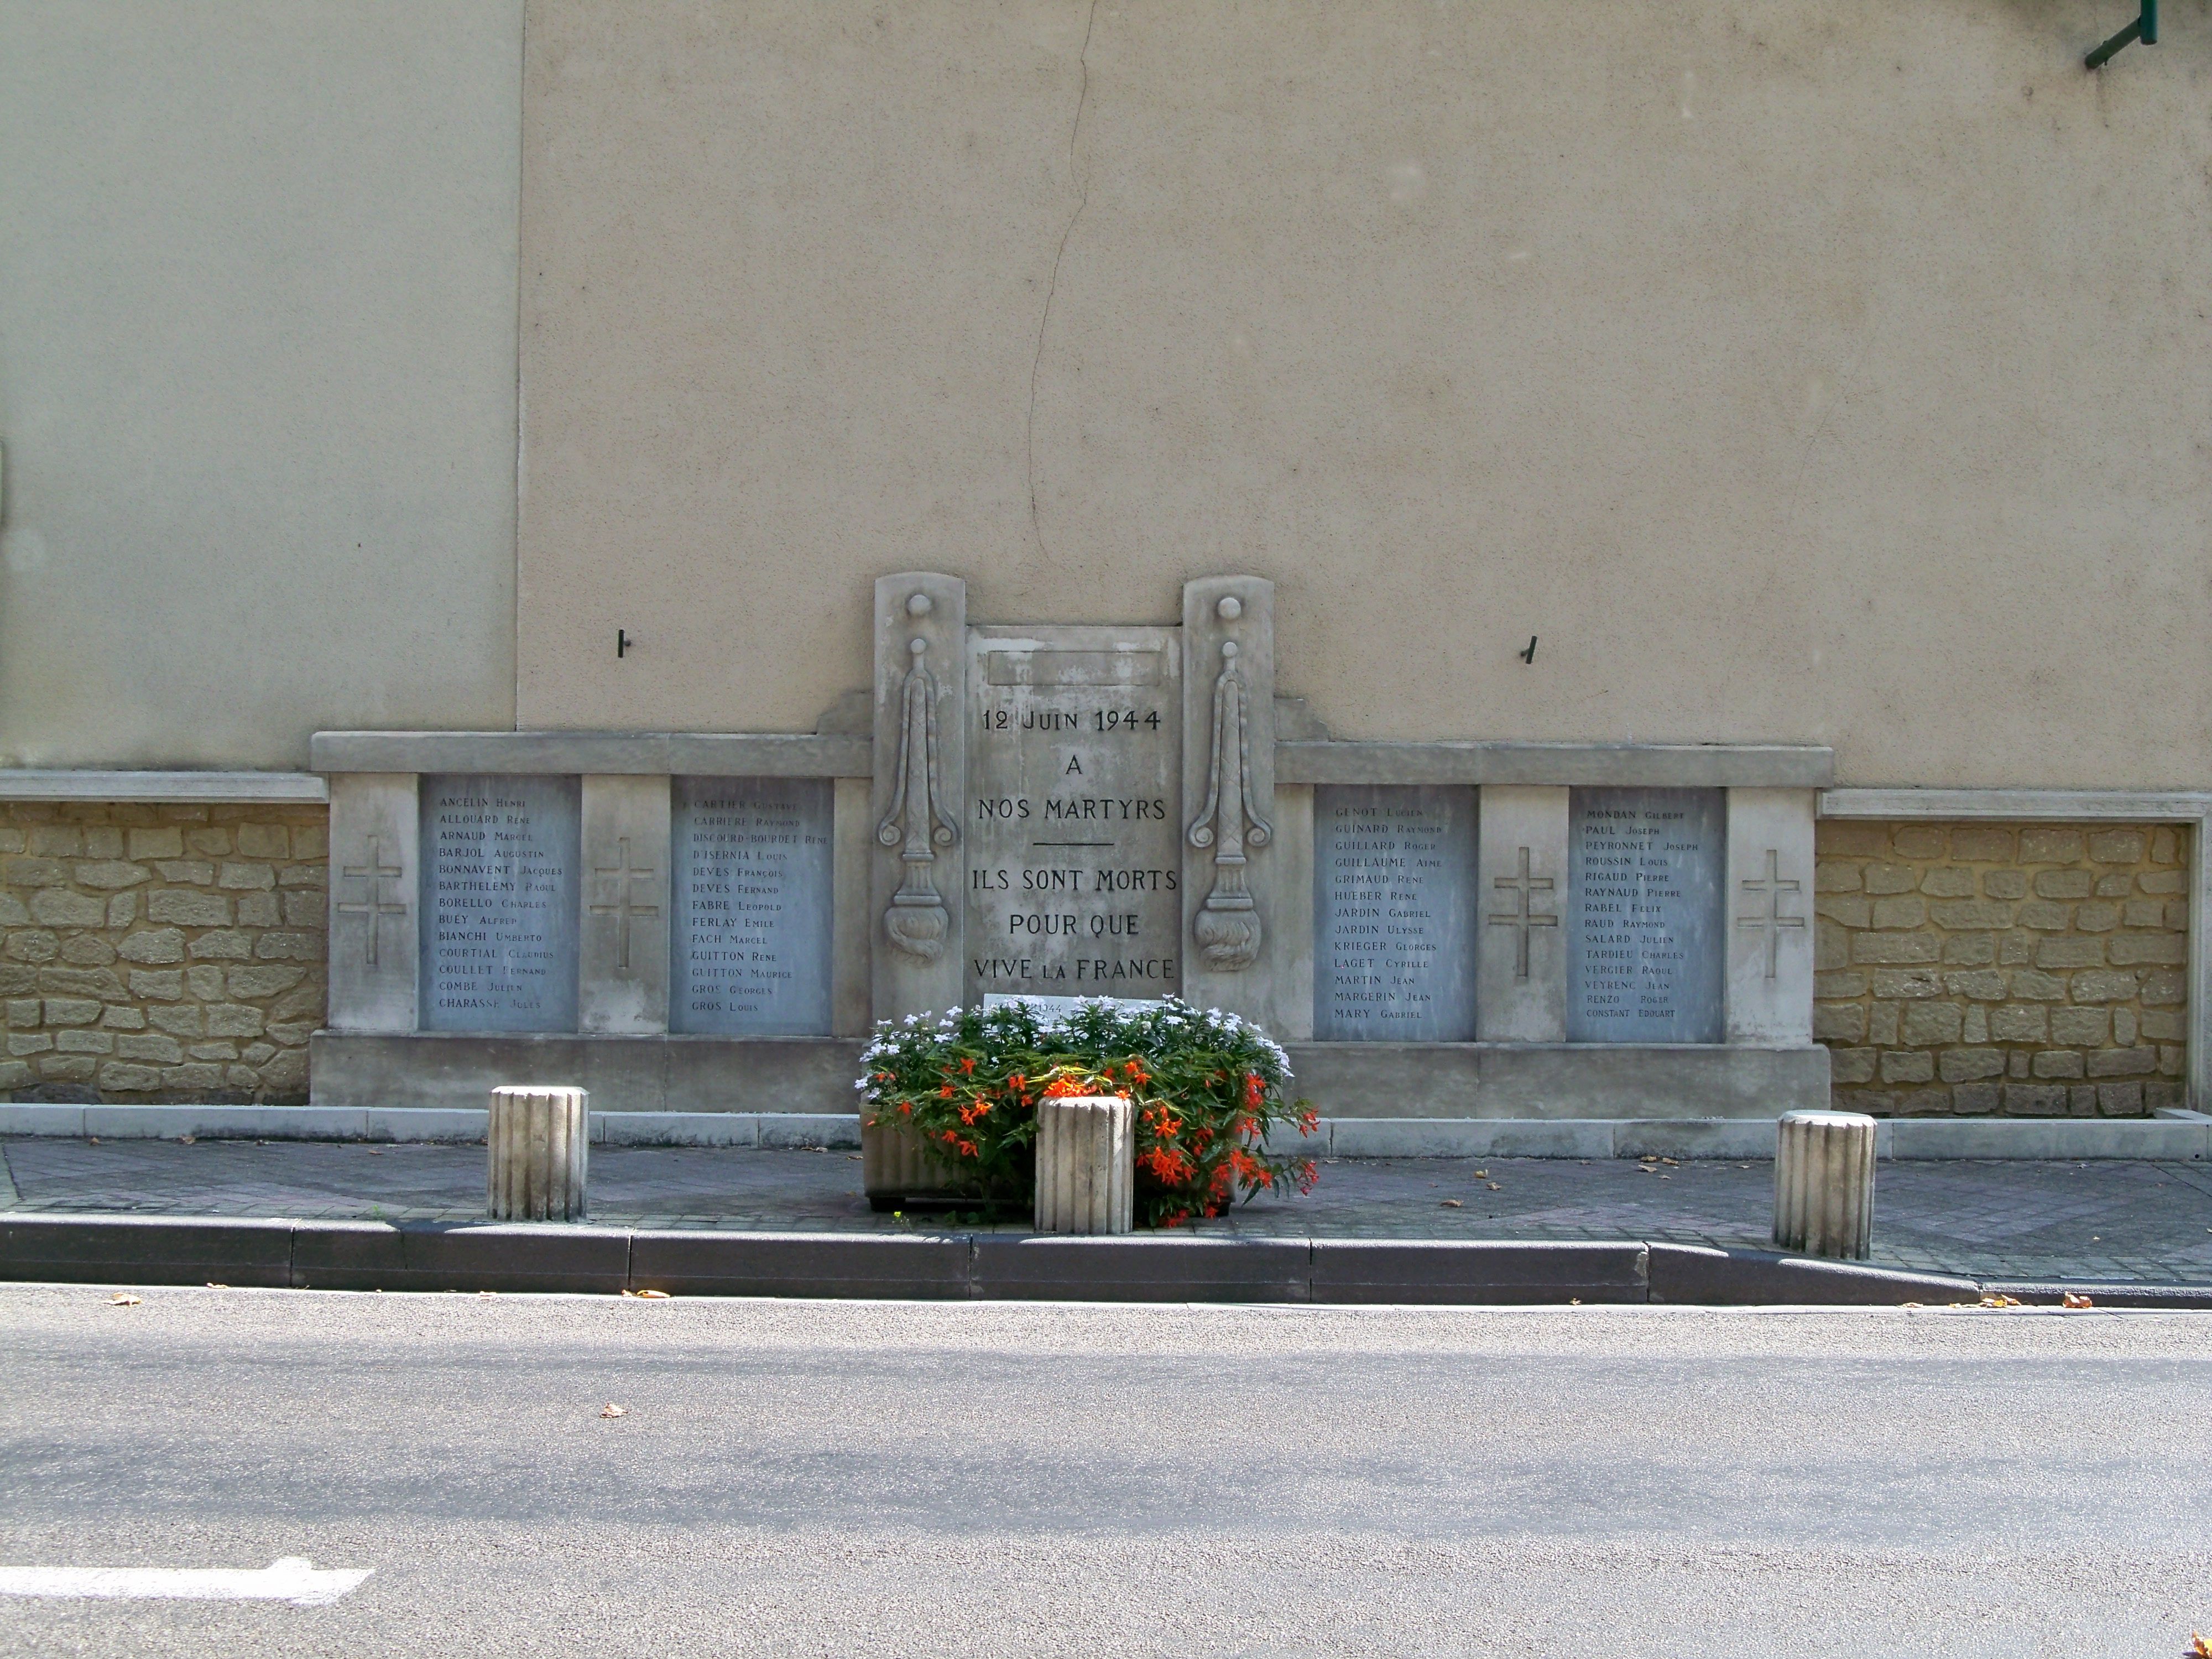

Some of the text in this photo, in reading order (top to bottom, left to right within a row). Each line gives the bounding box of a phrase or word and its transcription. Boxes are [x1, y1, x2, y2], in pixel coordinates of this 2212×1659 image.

[983, 709, 1009, 730] 12
[1095, 709, 1161, 732] 1944
[1066, 754, 1083, 775] A
[440, 798, 489, 807] ANCELIN
[978, 799, 1166, 820] NOS MARTYRS
[440, 815, 531, 824] ALLOUARD RENE
[1587, 810, 1684, 820] MONDAN GILBERT
[1335, 824, 1389, 834] GUINARD
[1585, 826, 1660, 835] PAUL JOSEPH
[440, 831, 486, 841] ARNAUD
[1335, 841, 1436, 851] GUILLARD ROGER
[1585, 841, 1698, 851] PEYRONNET JOSEPH
[439, 848, 544, 858] BARJOL AUGUSTIN
[757, 851, 787, 861] LOUIS
[1335, 858, 1442, 868] GUILLAUME AIME
[1585, 857, 1668, 867] ROUSSIN LOUIS
[439, 865, 562, 877] BONNAVENT JACQUES
[693, 867, 730, 877] DEVES
[972, 869, 1178, 891] ILS SONT MORTS
[1335, 875, 1424, 884] GRIMAUD RENE
[1585, 872, 1670, 882] RIGAUD PIERRE
[439, 881, 517, 891] BARTHELEMY
[692, 884, 779, 895] DEVES FERNAND
[1334, 891, 1417, 901] HUEBER RENE
[1584, 888, 1681, 898] RAYNAUD PIERRE
[439, 898, 547, 909] BORELLO CHARLES
[692, 900, 782, 911] FABRE LEOPOLD
[1584, 904, 1662, 913] RABEL FELIX
[1334, 908, 1431, 918] JARDIN GABRIEL
[439, 915, 469, 924] BUEY
[692, 917, 775, 928] FERLAY EMILE
[1584, 919, 1666, 928] RAUD RAYMOND
[1009, 914, 1139, 938] POUR QUE
[1334, 925, 1424, 935] JARDIN ULYSSE
[438, 931, 542, 942] BIANCHI UMBERTO
[692, 934, 768, 945] FACH MARCEL
[1585, 935, 1674, 944] SALARD JULIEN
[1334, 941, 1437, 951] KRIEGER GEORGES
[439, 948, 498, 958] COURTIAL
[691, 951, 777, 962] GUITTON RENE
[1585, 950, 1684, 959] TARDIEU CHARLES
[1334, 958, 1428, 968] LAGET CYRILLE
[439, 965, 493, 975] COULLET
[750, 969, 792, 979] MAURICE
[973, 958, 1032, 979] VIVE
[1077, 959, 1175, 980] FRANCE
[1584, 966, 1673, 975] VERGIER RAOUL
[1334, 975, 1415, 985] MARTIN JEAN
[1584, 980, 1670, 990] VEYRENC JEAN
[439, 982, 478, 991] COMBE
[692, 985, 722, 994] GROS
[1334, 992, 1431, 1002] MARGERIN JEAN
[1587, 995, 1668, 1004] RENZO ROGER
[692, 1001, 758, 1012] GROS LOUIS
[1334, 1009, 1423, 1019] MARY GABRIEL
